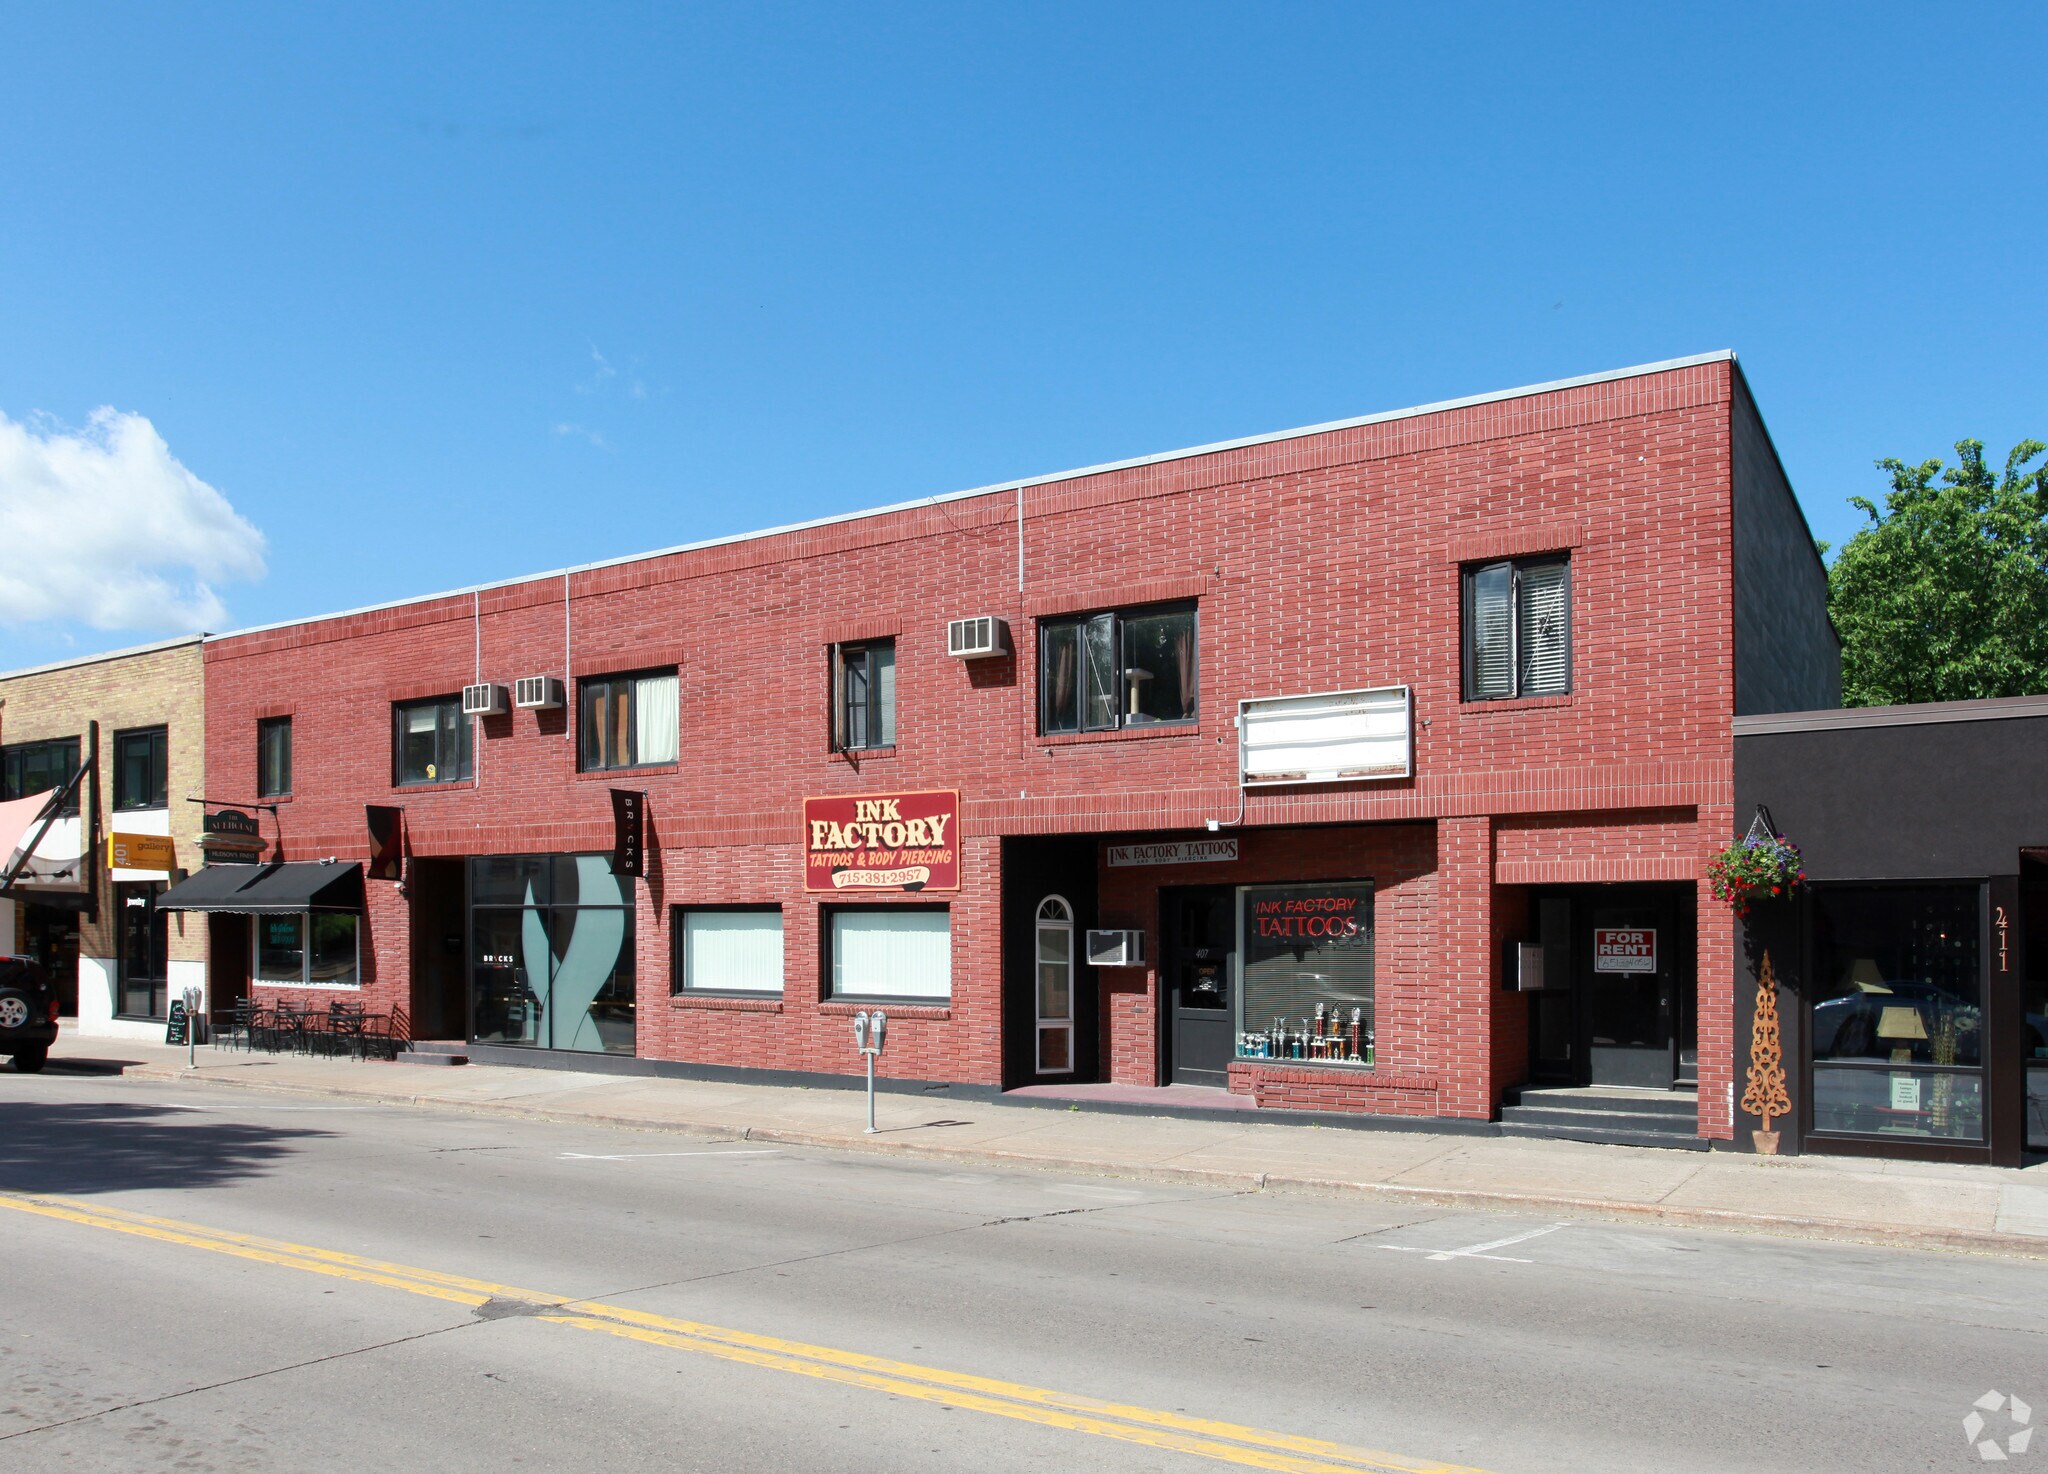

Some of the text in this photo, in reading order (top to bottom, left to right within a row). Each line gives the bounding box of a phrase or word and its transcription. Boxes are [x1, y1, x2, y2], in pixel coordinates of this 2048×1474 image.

[855, 798, 902, 823] INK
[810, 812, 952, 851] FACTORY
[114, 843, 127, 865] 401
[137, 842, 171, 853] gallery
[1109, 840, 1237, 865] INK FACTORY TATTOOS
[809, 849, 953, 867] TATTOOS & BODY PIERCING
[1255, 897, 1357, 915] INK FACTORY
[1257, 915, 1359, 937] TATTOOS
[1605, 932, 1644, 944] FOR
[1994, 906, 2009, 972] 411
[1195, 949, 1209, 959] 407
[1599, 944, 1651, 955] RENT
